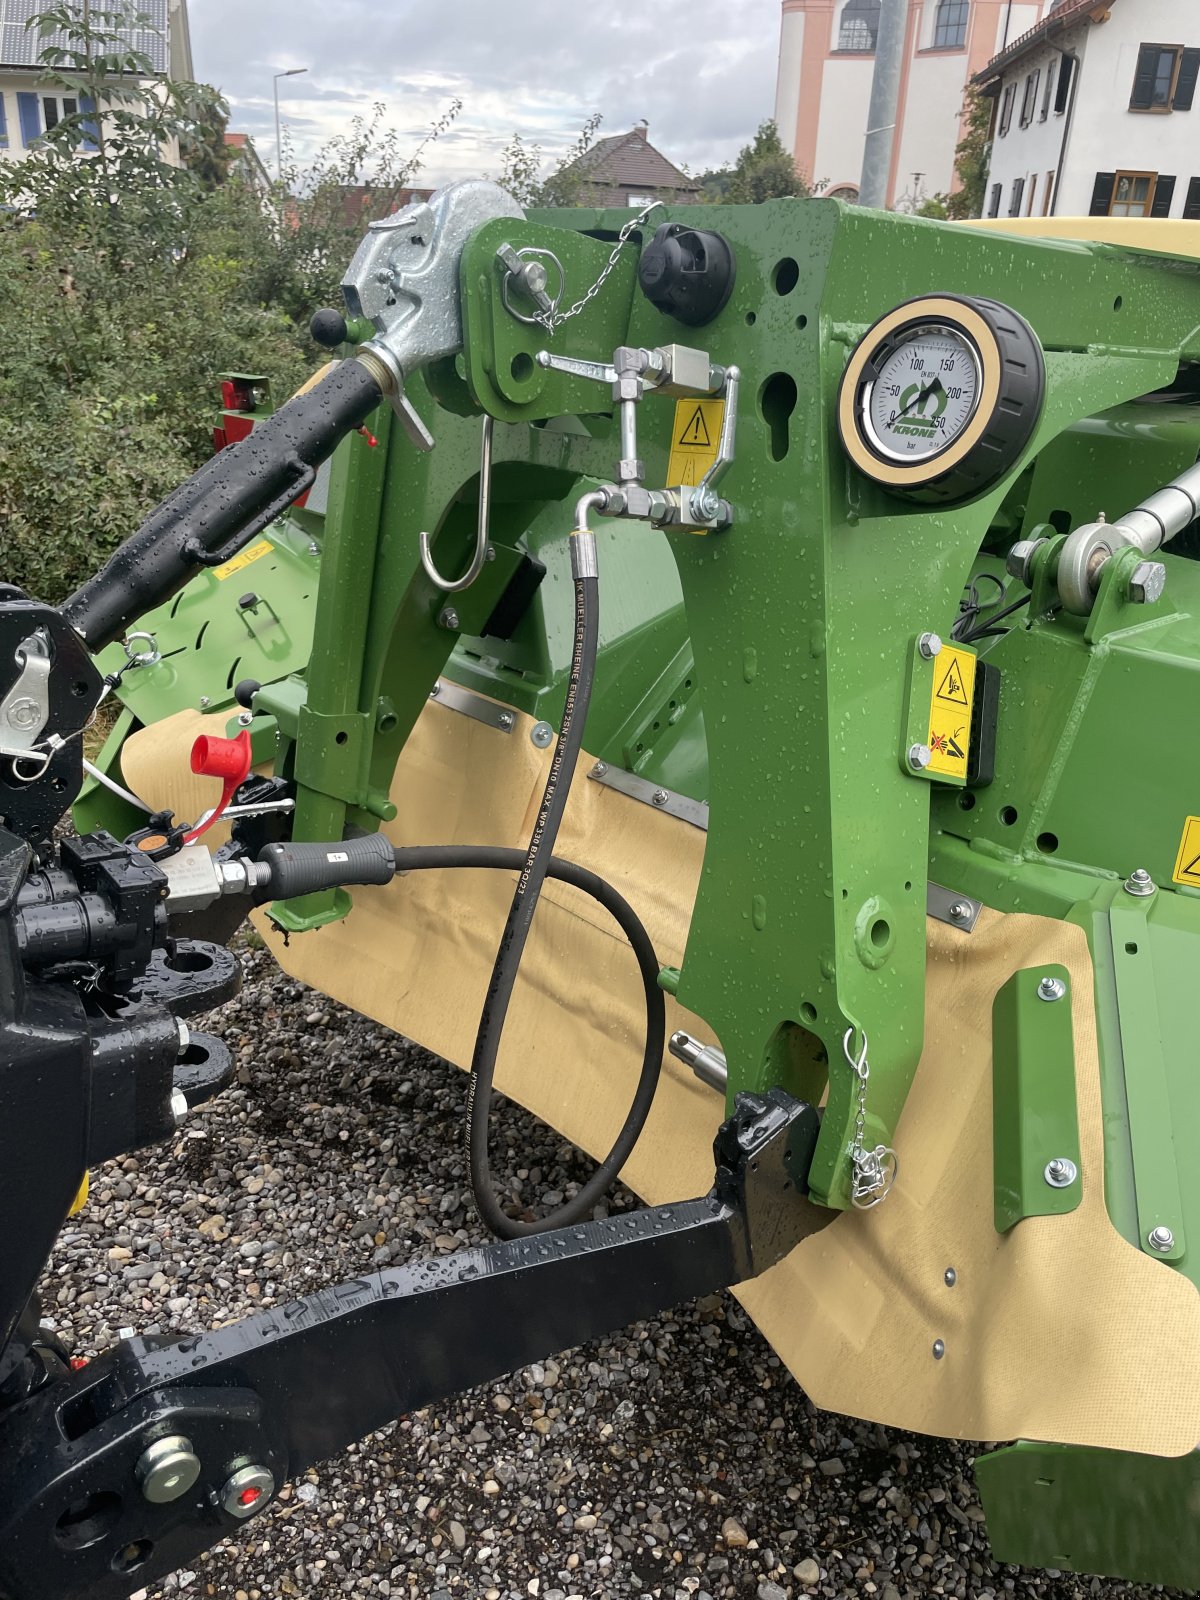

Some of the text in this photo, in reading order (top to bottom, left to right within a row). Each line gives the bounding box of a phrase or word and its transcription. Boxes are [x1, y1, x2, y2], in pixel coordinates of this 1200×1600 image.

[910, 359, 924, 370] 100
[940, 359, 954, 371] 150
[890, 385, 900, 396] 50
[946, 387, 961, 399] 200
[890, 410, 895, 421] 0
[930, 416, 946, 428] 250
[892, 425, 937, 438] KRONE
[907, 441, 916, 449] bar
[576, 593, 585, 640] MUELLER
[571, 643, 583, 679] RHEINE
[566, 684, 577, 714] EN853
[562, 716, 571, 735] 2SN
[551, 757, 562, 781] DN10
[533, 827, 543, 844] 330
[526, 845, 538, 867] BAR
